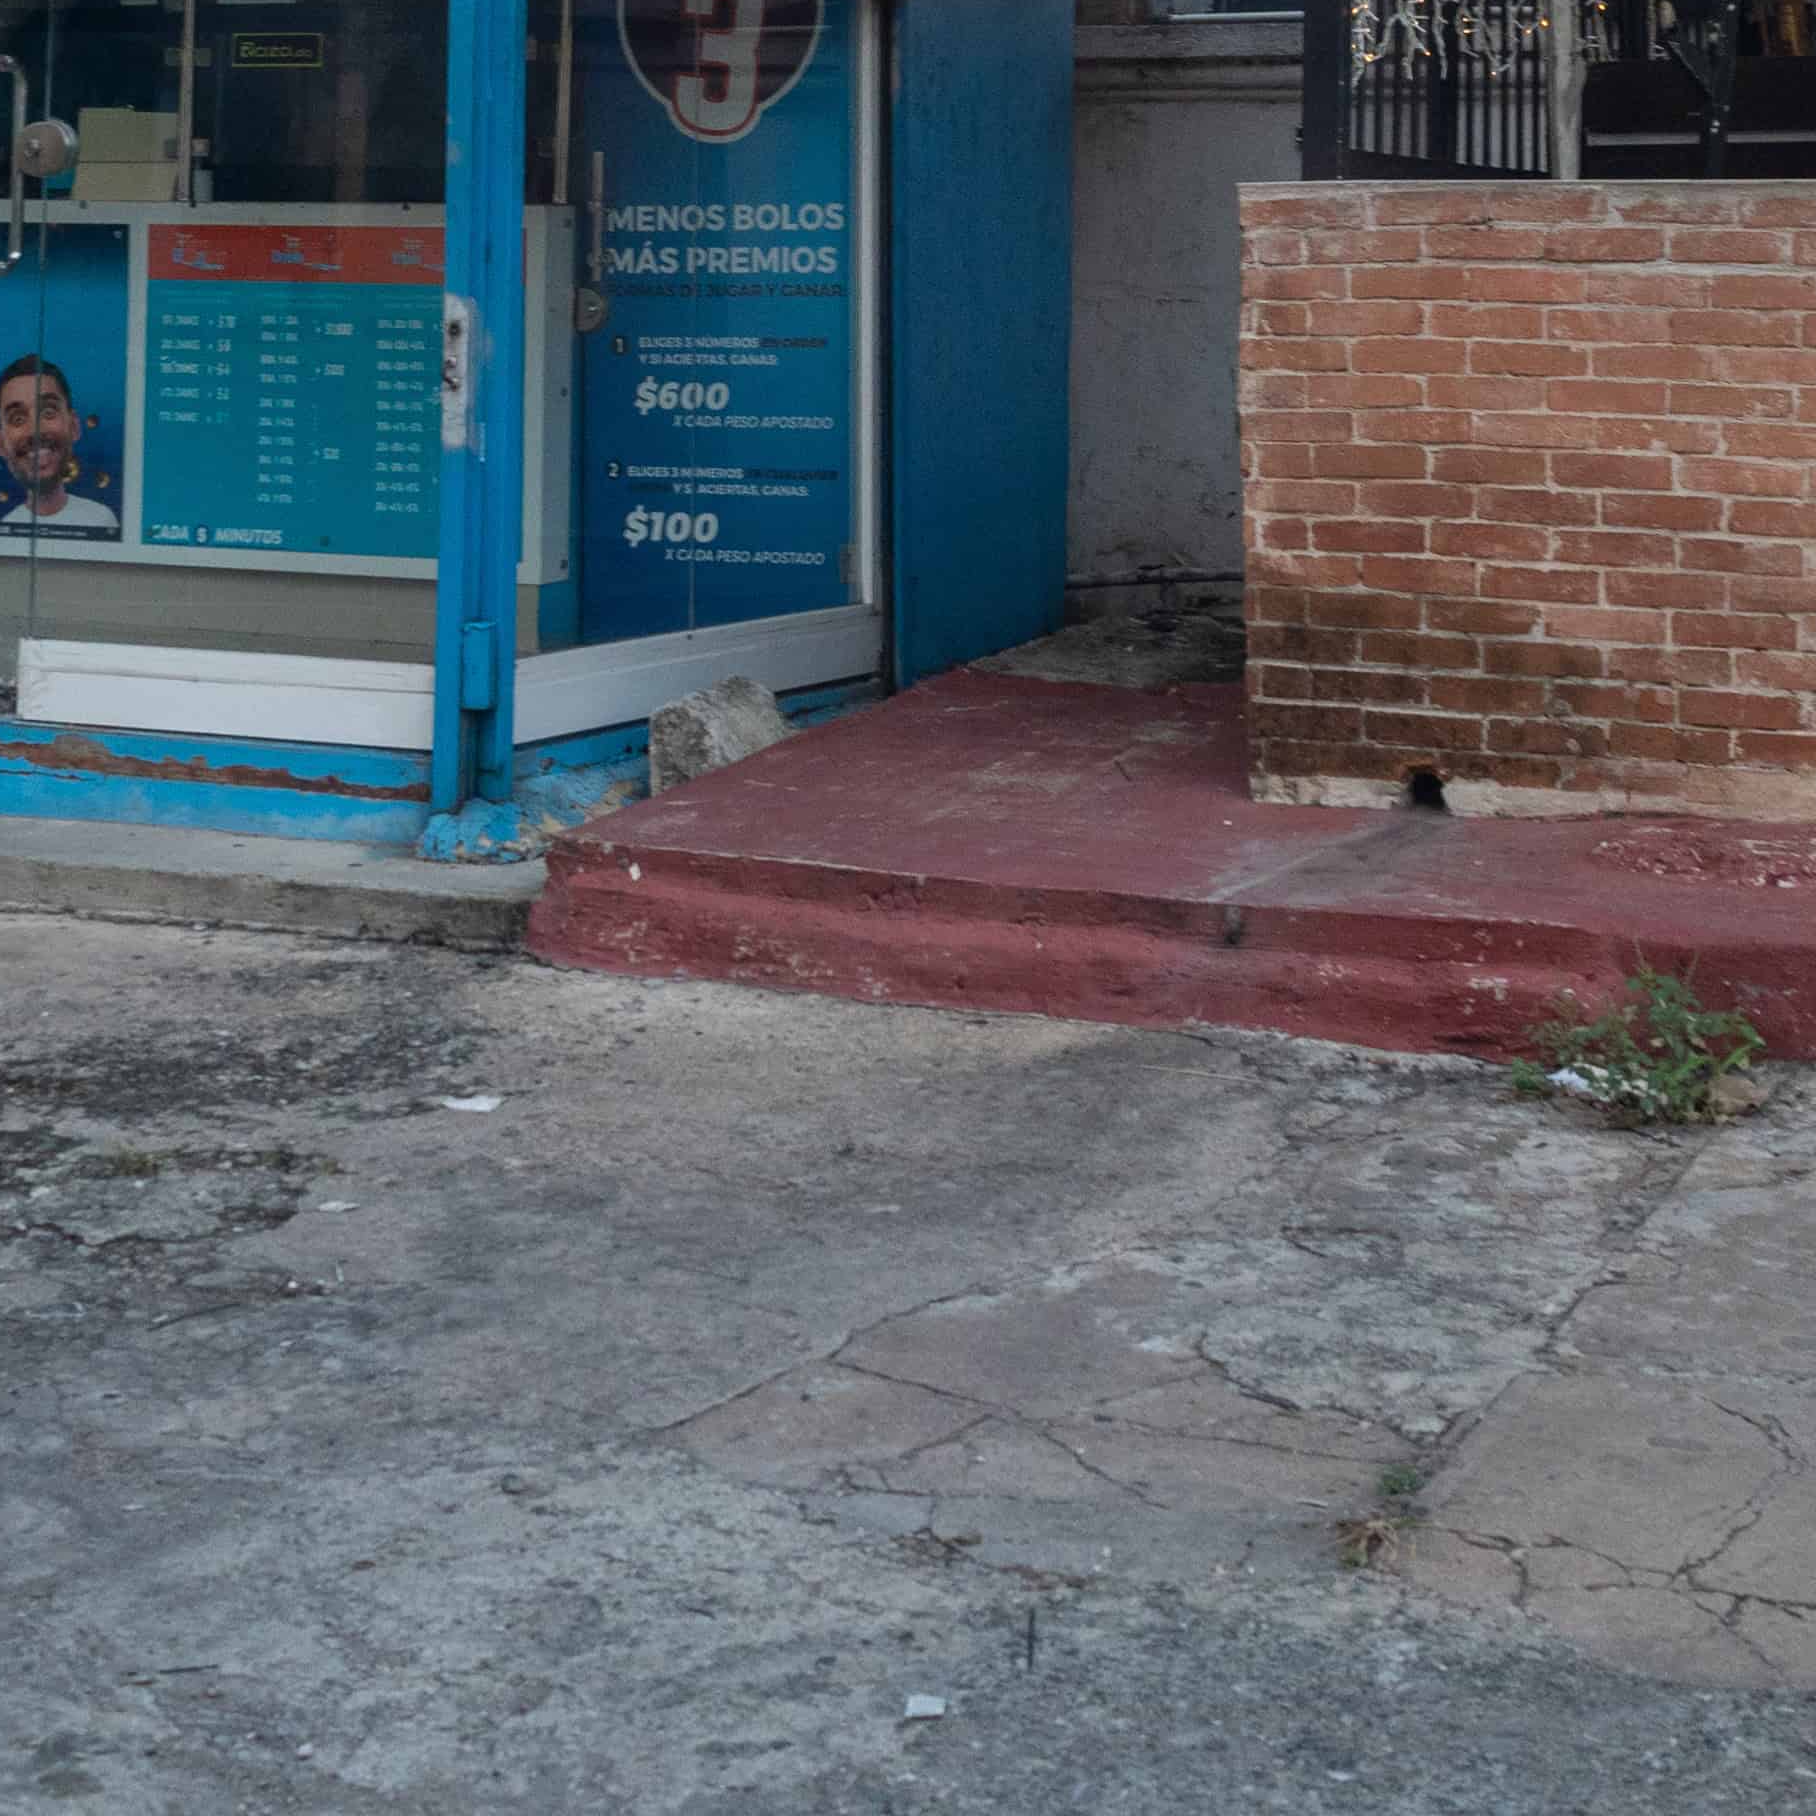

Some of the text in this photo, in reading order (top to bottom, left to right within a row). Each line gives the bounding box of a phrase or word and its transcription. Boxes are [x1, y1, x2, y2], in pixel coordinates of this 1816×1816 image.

[607, 203, 845, 233] MENOS BOLOS
[607, 241, 839, 275] MÁS PREMIOS
[634, 376, 730, 416] $600
[724, 416, 759, 429] PESO
[760, 416, 834, 430] APOSTADO
[609, 463, 620, 478] 2
[196, 527, 208, 544] 5
[214, 527, 284, 546] MINUTOS
[623, 504, 719, 548] $100
[715, 550, 750, 563] PESO
[751, 551, 825, 566] APOSTADO
